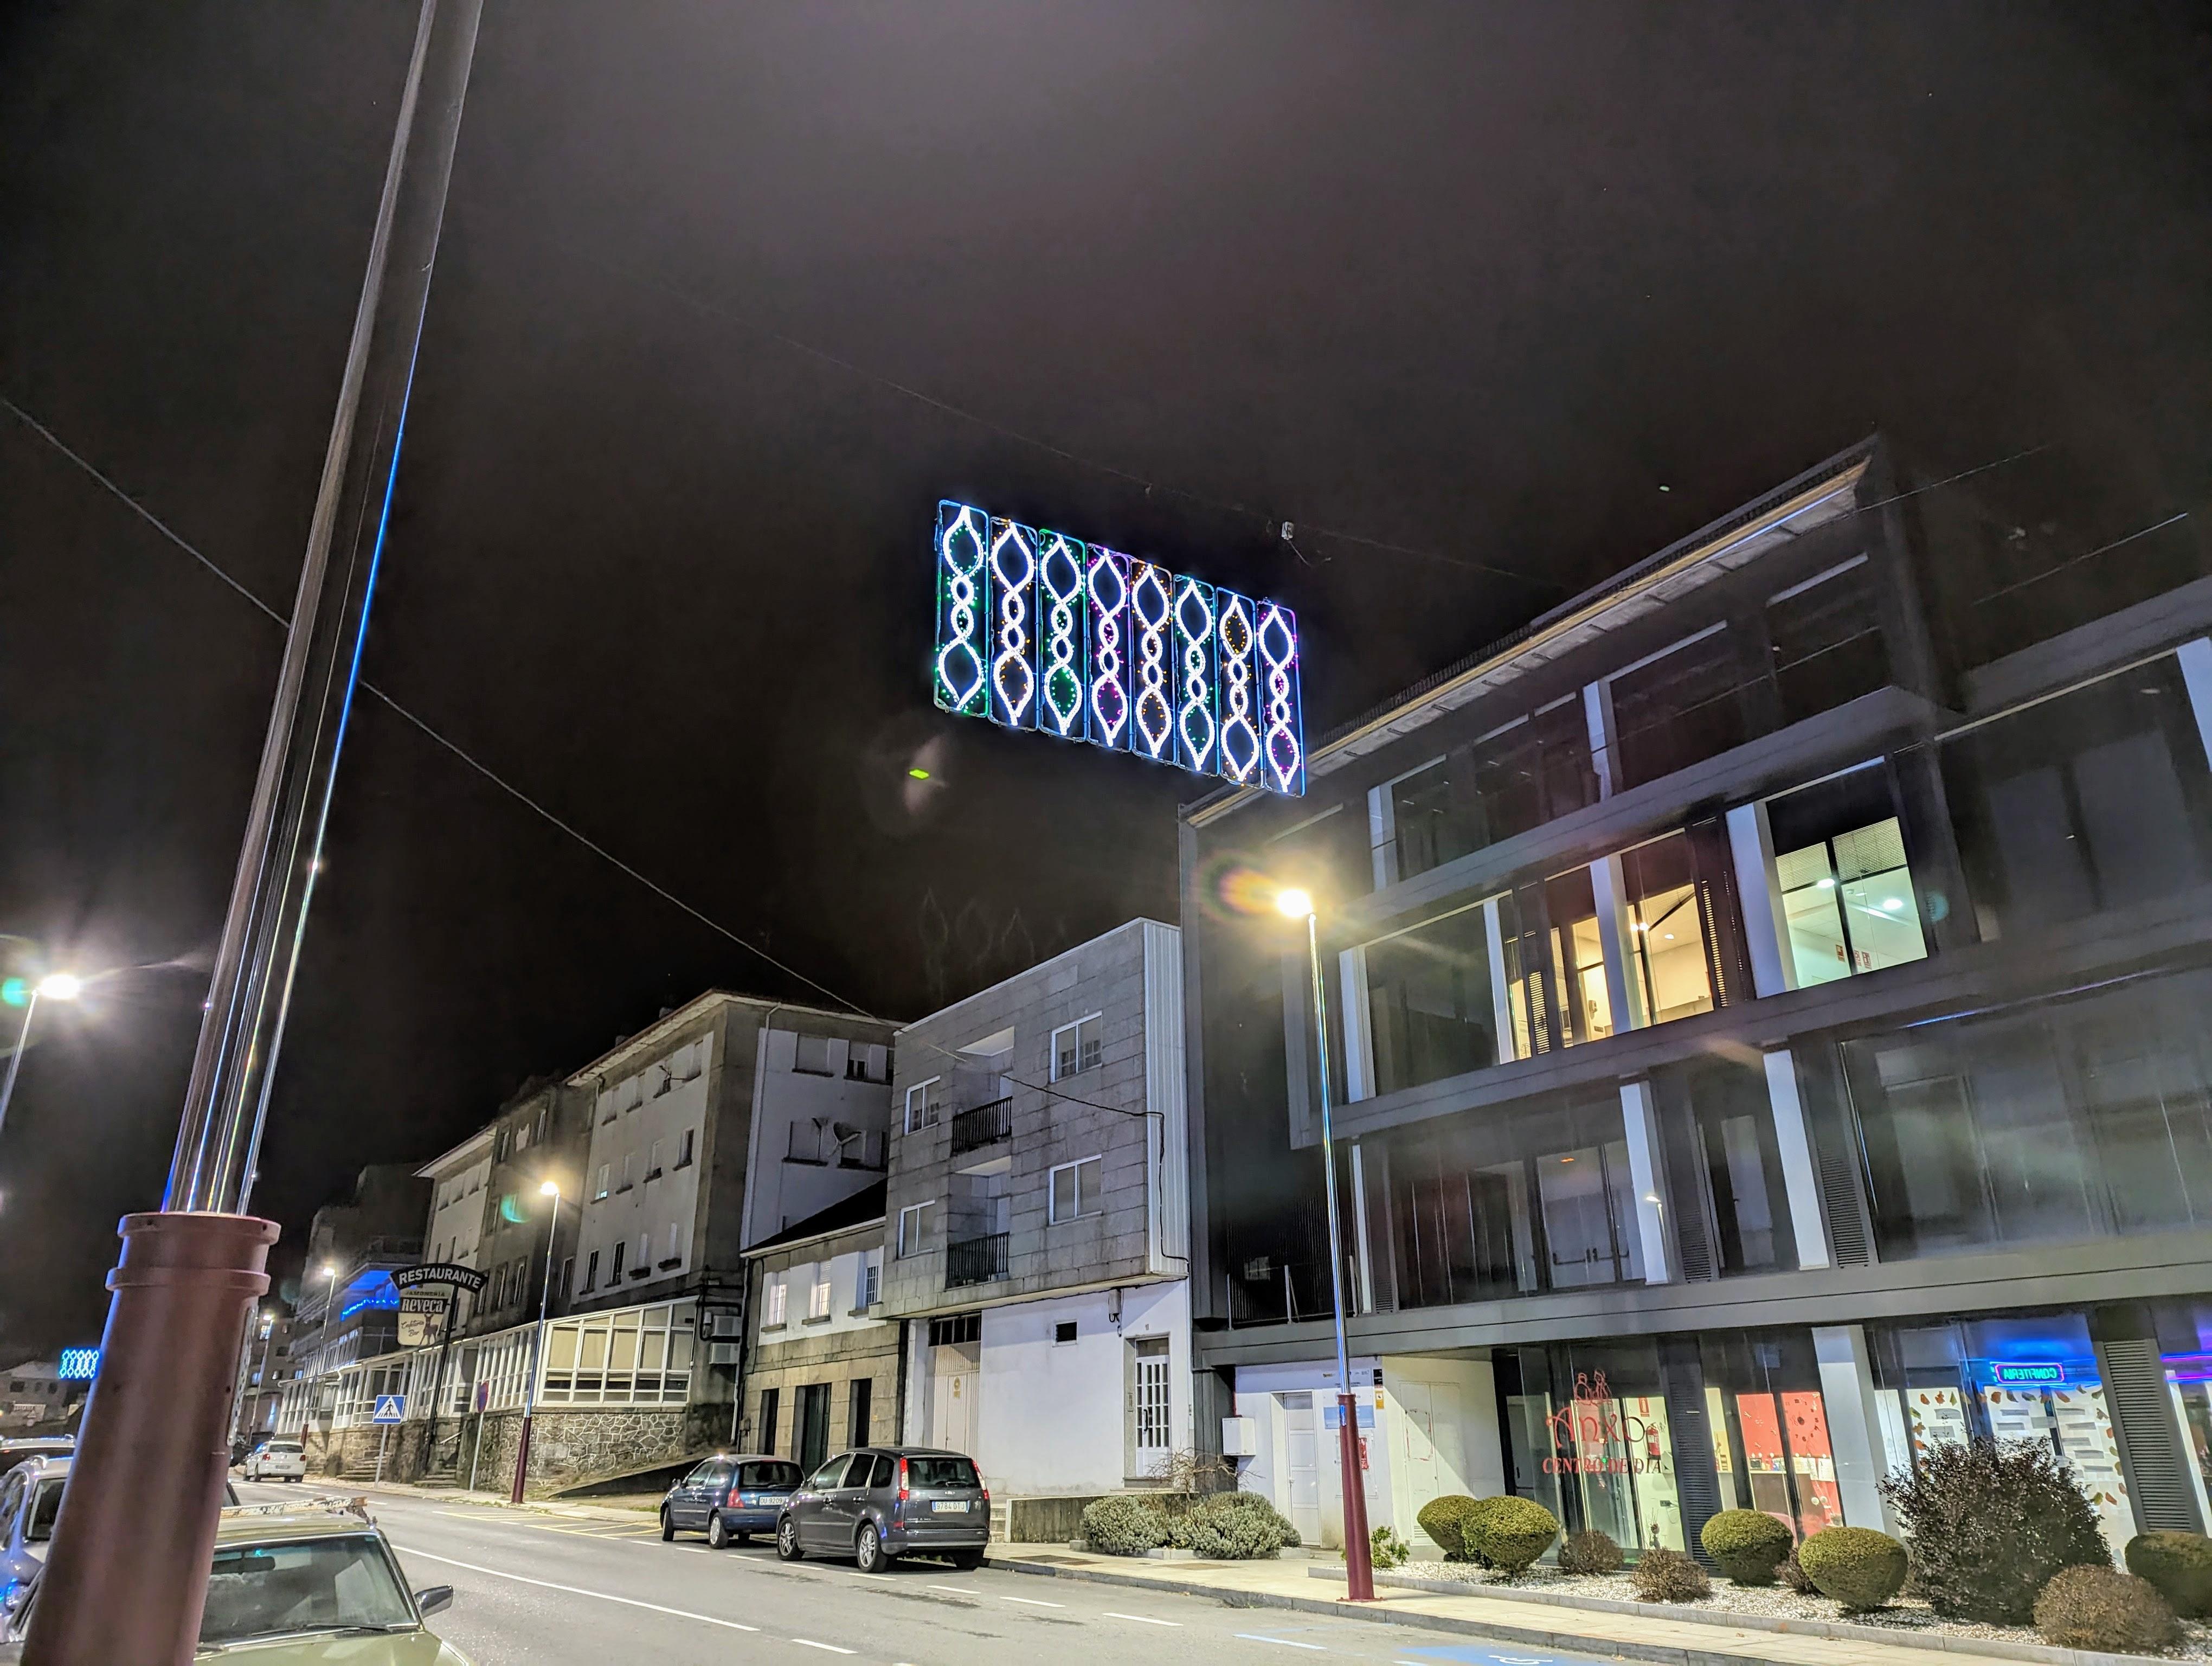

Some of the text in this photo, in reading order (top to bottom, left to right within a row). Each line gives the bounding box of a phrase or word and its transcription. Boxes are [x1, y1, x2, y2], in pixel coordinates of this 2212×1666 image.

[398, 1267, 481, 1289] RESTAURANTE
[1542, 1457, 1603, 1474] CENTRO
[1607, 1457, 1629, 1473] DE
